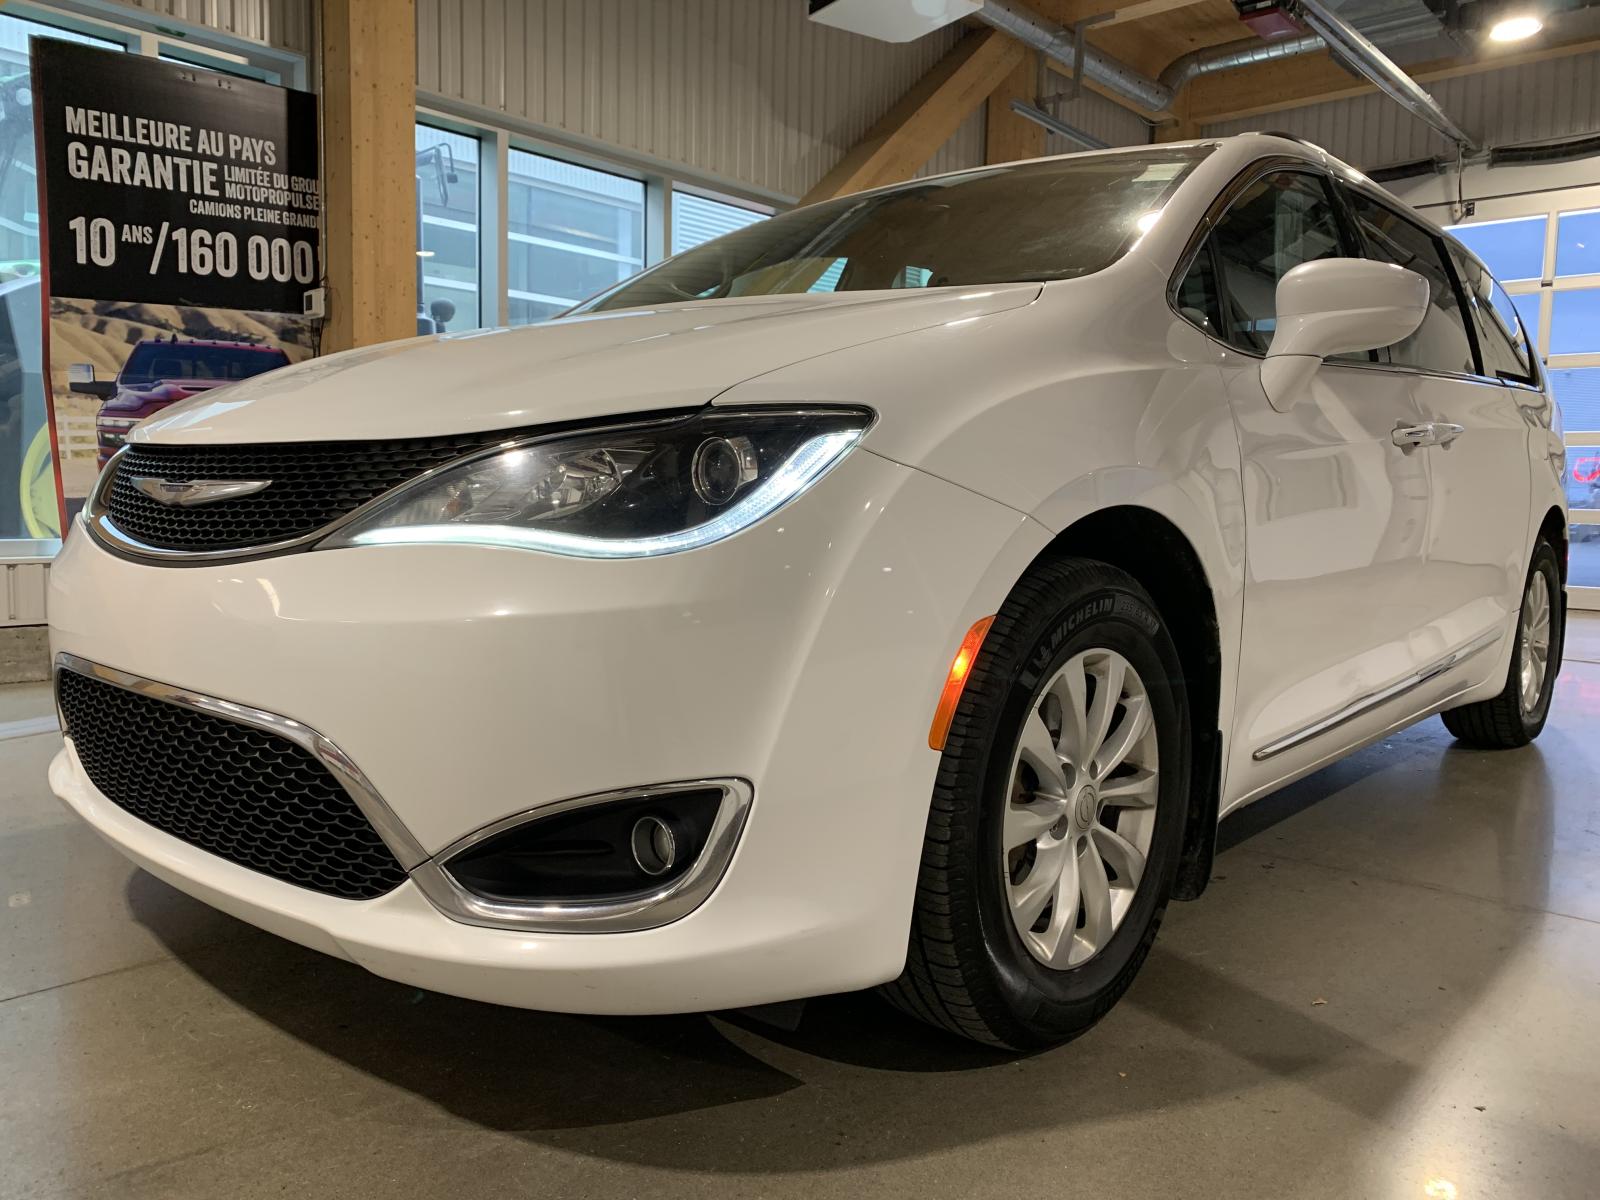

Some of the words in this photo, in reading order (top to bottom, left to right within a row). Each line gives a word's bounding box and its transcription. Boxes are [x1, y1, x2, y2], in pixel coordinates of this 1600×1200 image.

[65, 105, 193, 152] MEILLEURE
[197, 128, 224, 157] AU
[228, 133, 276, 166] PAYS
[67, 141, 220, 197] GARANTIE
[224, 165, 271, 188] LIMITÉE
[273, 173, 289, 190] DU
[189, 199, 242, 219] CAMIONS
[243, 205, 281, 225] PLEINE
[69, 216, 116, 267] 10
[247, 234, 314, 284] 000
[1050, 598, 1114, 648] MICHELIN
